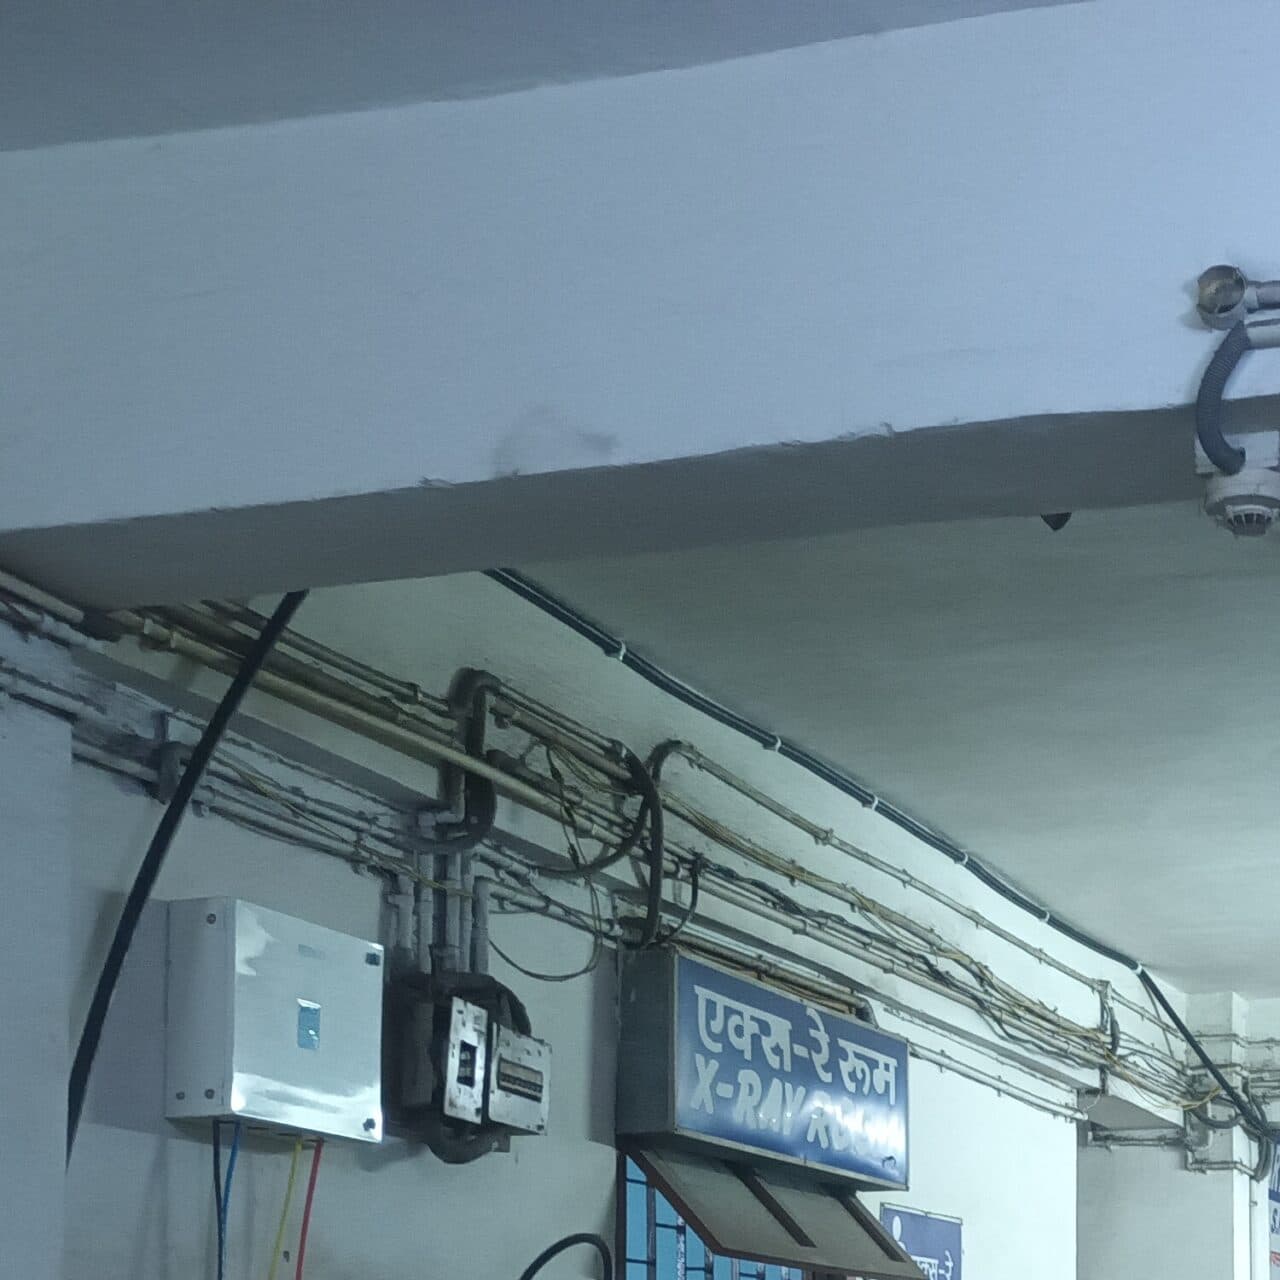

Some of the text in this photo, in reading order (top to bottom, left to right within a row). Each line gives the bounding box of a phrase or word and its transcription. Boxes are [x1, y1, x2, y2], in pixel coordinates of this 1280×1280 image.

[693, 984, 898, 1106] एक्स-रे रूम
[693, 1052, 807, 1135] X-RAY
